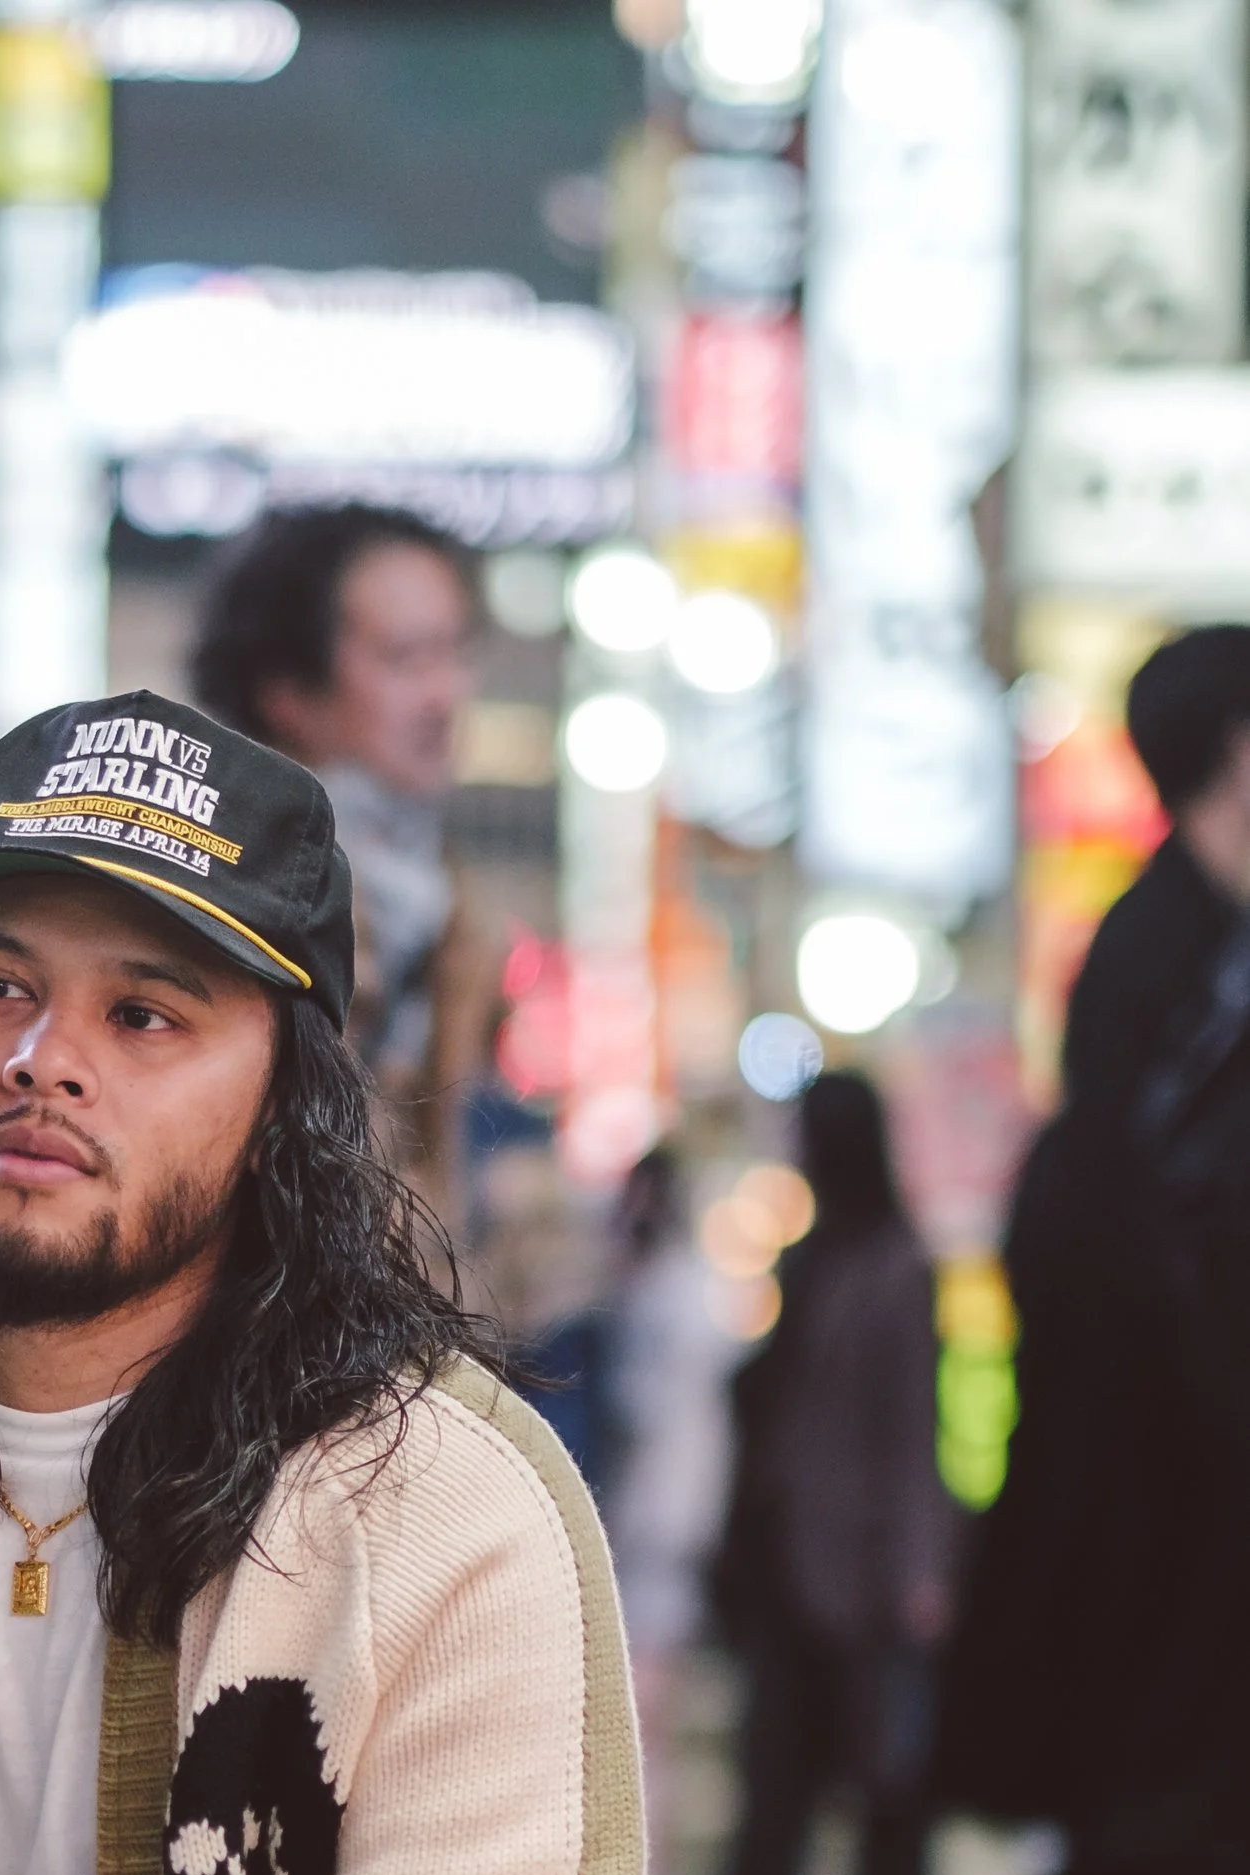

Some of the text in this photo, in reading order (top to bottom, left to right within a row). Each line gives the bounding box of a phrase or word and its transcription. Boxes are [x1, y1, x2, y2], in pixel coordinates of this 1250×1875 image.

[67, 717, 211, 774] NUNN VS
[36, 757, 220, 826] STARLING
[9, 816, 210, 870] THE MIRAGE APRIL 14
[139, 809, 241, 859] CHAMPIONSHIP
